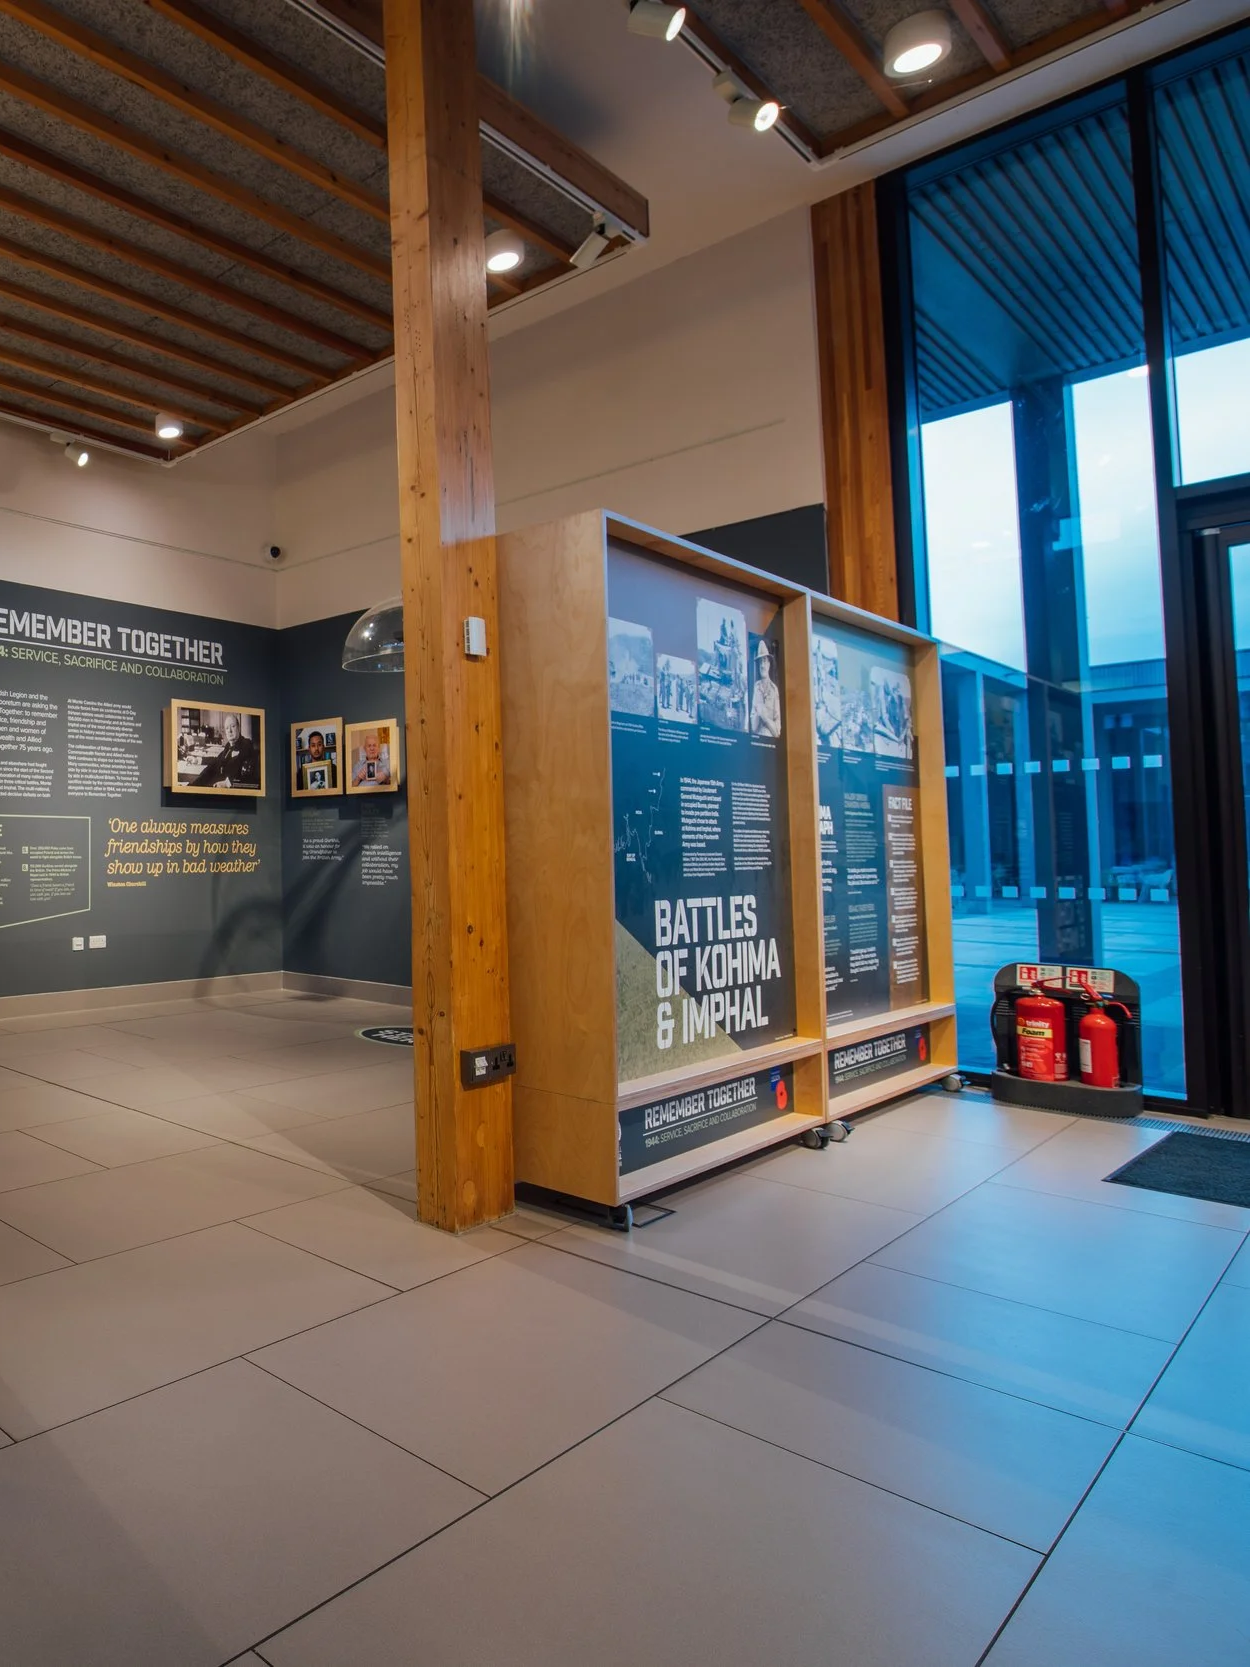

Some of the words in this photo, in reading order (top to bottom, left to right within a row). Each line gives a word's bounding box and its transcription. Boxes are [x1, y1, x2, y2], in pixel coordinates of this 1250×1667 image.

[117, 628, 223, 665] TOGETHER
[64, 654, 117, 671] SACRIFICE
[120, 662, 142, 675] AND
[146, 665, 224, 685] COLLABORATION
[9, 690, 28, 700] Legion
[31, 702, 48, 711] asking
[31, 711, 58, 719] remember
[902, 798, 912, 810] FILE
[141, 820, 187, 837] always
[190, 822, 248, 835] measures
[105, 839, 182, 857] friendships
[186, 841, 200, 857] by
[203, 840, 228, 854] how
[232, 841, 256, 856] they
[107, 859, 143, 874] show
[146, 862, 163, 876] up
[167, 860, 179, 873] in
[182, 859, 206, 873] bad
[655, 895, 757, 946] BATTLES
[656, 949, 688, 998] OF
[696, 938, 781, 992] KOHIMA
[657, 1002, 674, 1049] &
[682, 985, 768, 1044] IMPHAL
[1026, 1020, 1049, 1028] trinity
[834, 1044, 873, 1069] REMEMBER
[874, 1034, 906, 1057] TOGETHER
[645, 1092, 705, 1130] REMEMBER
[708, 1077, 755, 1106] TOGETHER
[645, 1136, 659, 1148] 1944:
[684, 1121, 708, 1134] SACRIFICE
[709, 1117, 719, 1127] AND
[720, 1104, 756, 1123] COLLABORATION
